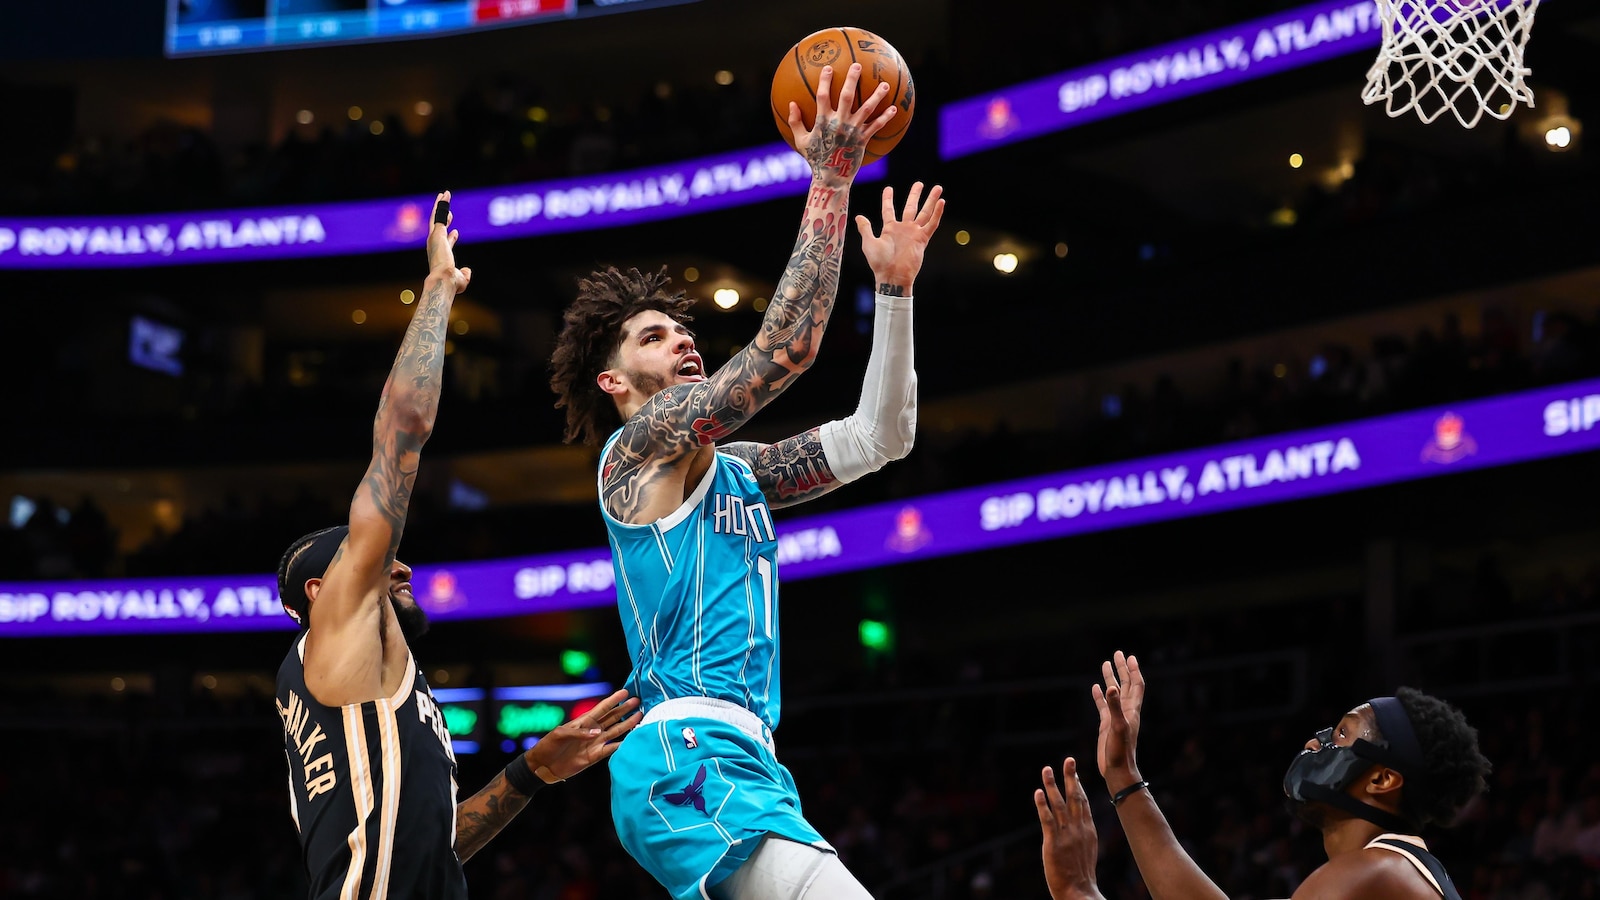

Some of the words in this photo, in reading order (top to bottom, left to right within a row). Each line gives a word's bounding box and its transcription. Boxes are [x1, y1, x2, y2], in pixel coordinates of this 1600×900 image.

[1058, 74, 1108, 113] SIP
[1109, 36, 1250, 99] ROYALLY,
[489, 194, 543, 226] SIP
[544, 173, 690, 219] ROYALLY,
[18, 224, 175, 257] ROYALLY,
[177, 215, 326, 251] ATLANTA
[980, 491, 1035, 531] SIP
[1036, 465, 1195, 522] ROYALLY,
[1197, 437, 1361, 496] ATLANTA
[51, 588, 210, 623] ROYALLY,
[514, 565, 566, 600] SIP
[757, 555, 773, 640] 1
